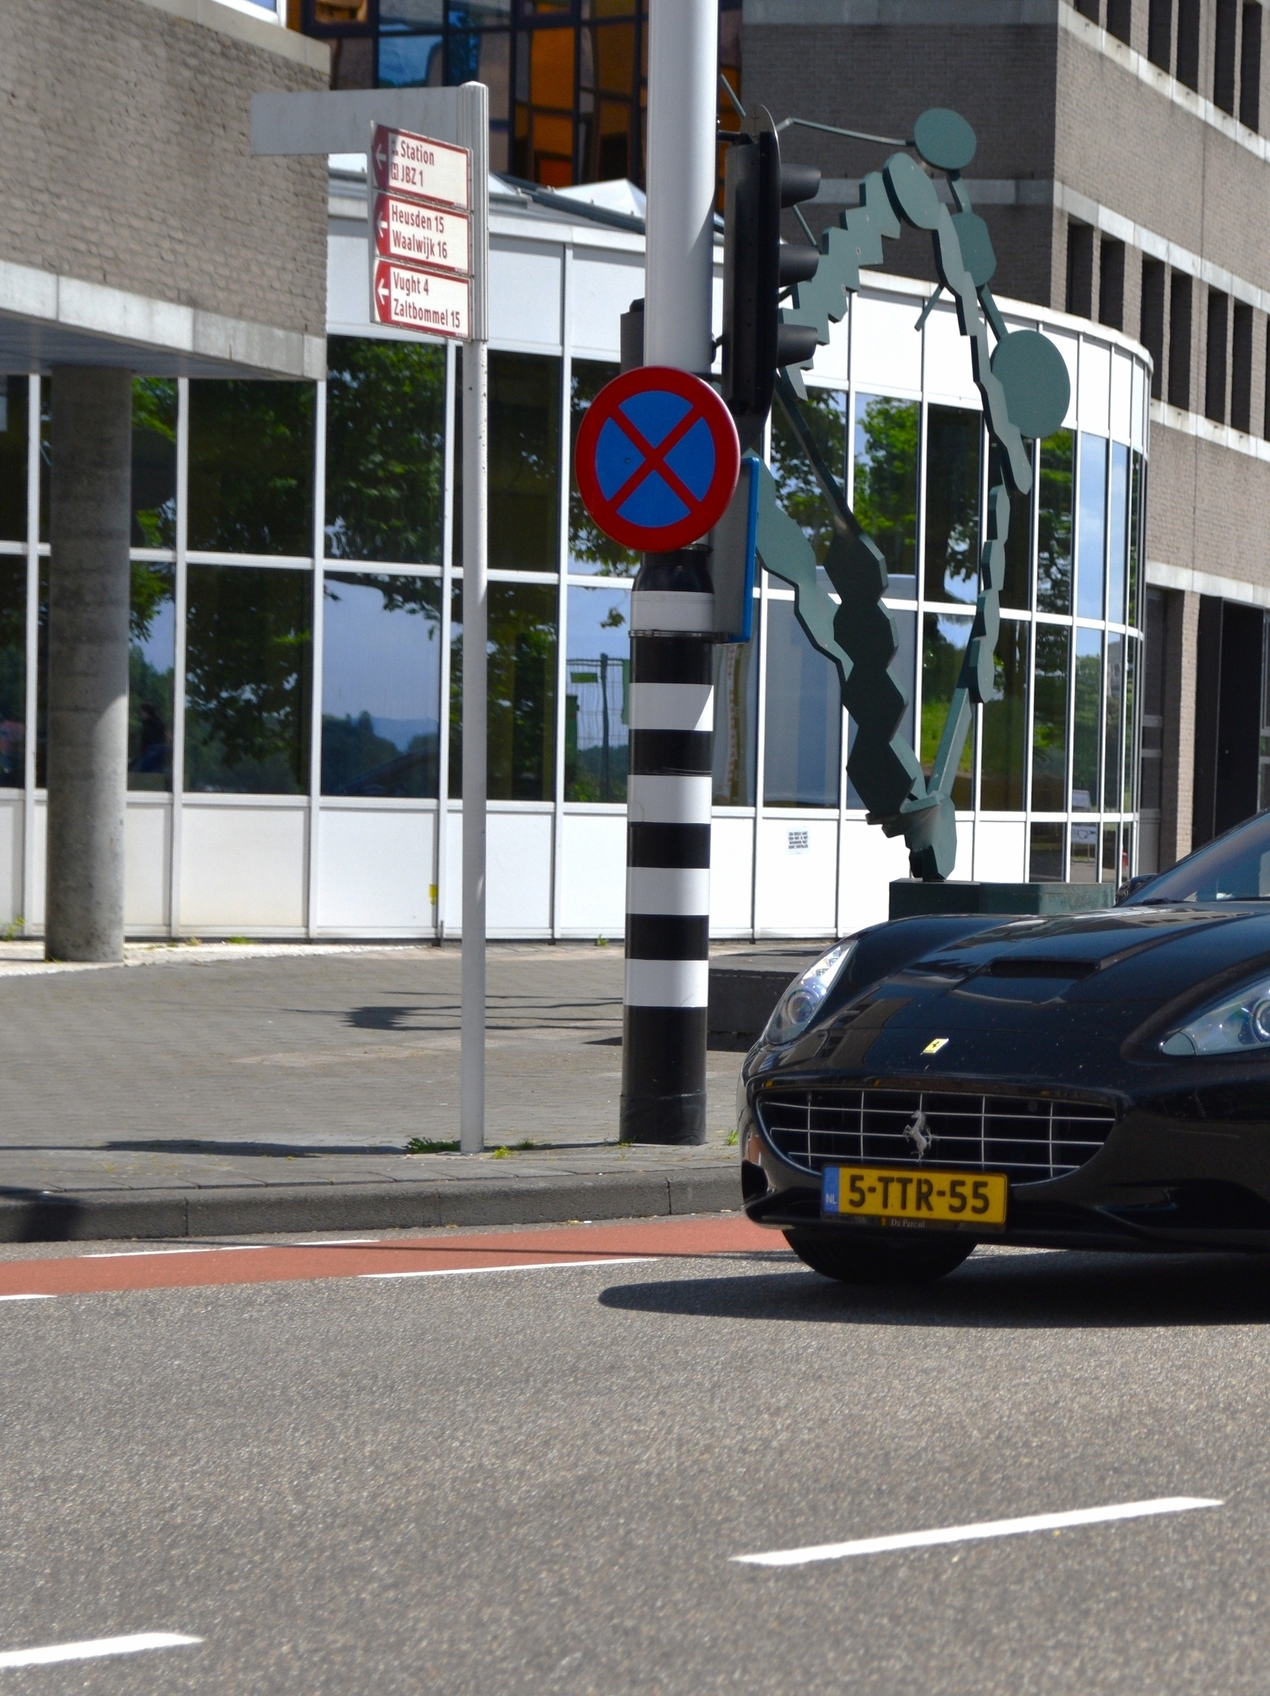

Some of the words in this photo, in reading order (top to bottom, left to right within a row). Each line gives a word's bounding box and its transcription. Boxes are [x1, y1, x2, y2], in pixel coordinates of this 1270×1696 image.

[400, 140, 435, 166] Station
[401, 165, 417, 185] JBZ
[419, 170, 424, 187] 1
[391, 203, 432, 231] Heusden
[434, 216, 445, 234] 15
[392, 230, 435, 260] Waalwijk
[437, 240, 448, 259] 16
[393, 271, 421, 297] Vught
[423, 278, 430, 296] 4
[393, 298, 449, 327] Zaltbommel
[450, 311, 461, 328] 15
[825, 1193, 838, 1205] NL
[848, 1173, 991, 1215] 5-TTR-55
